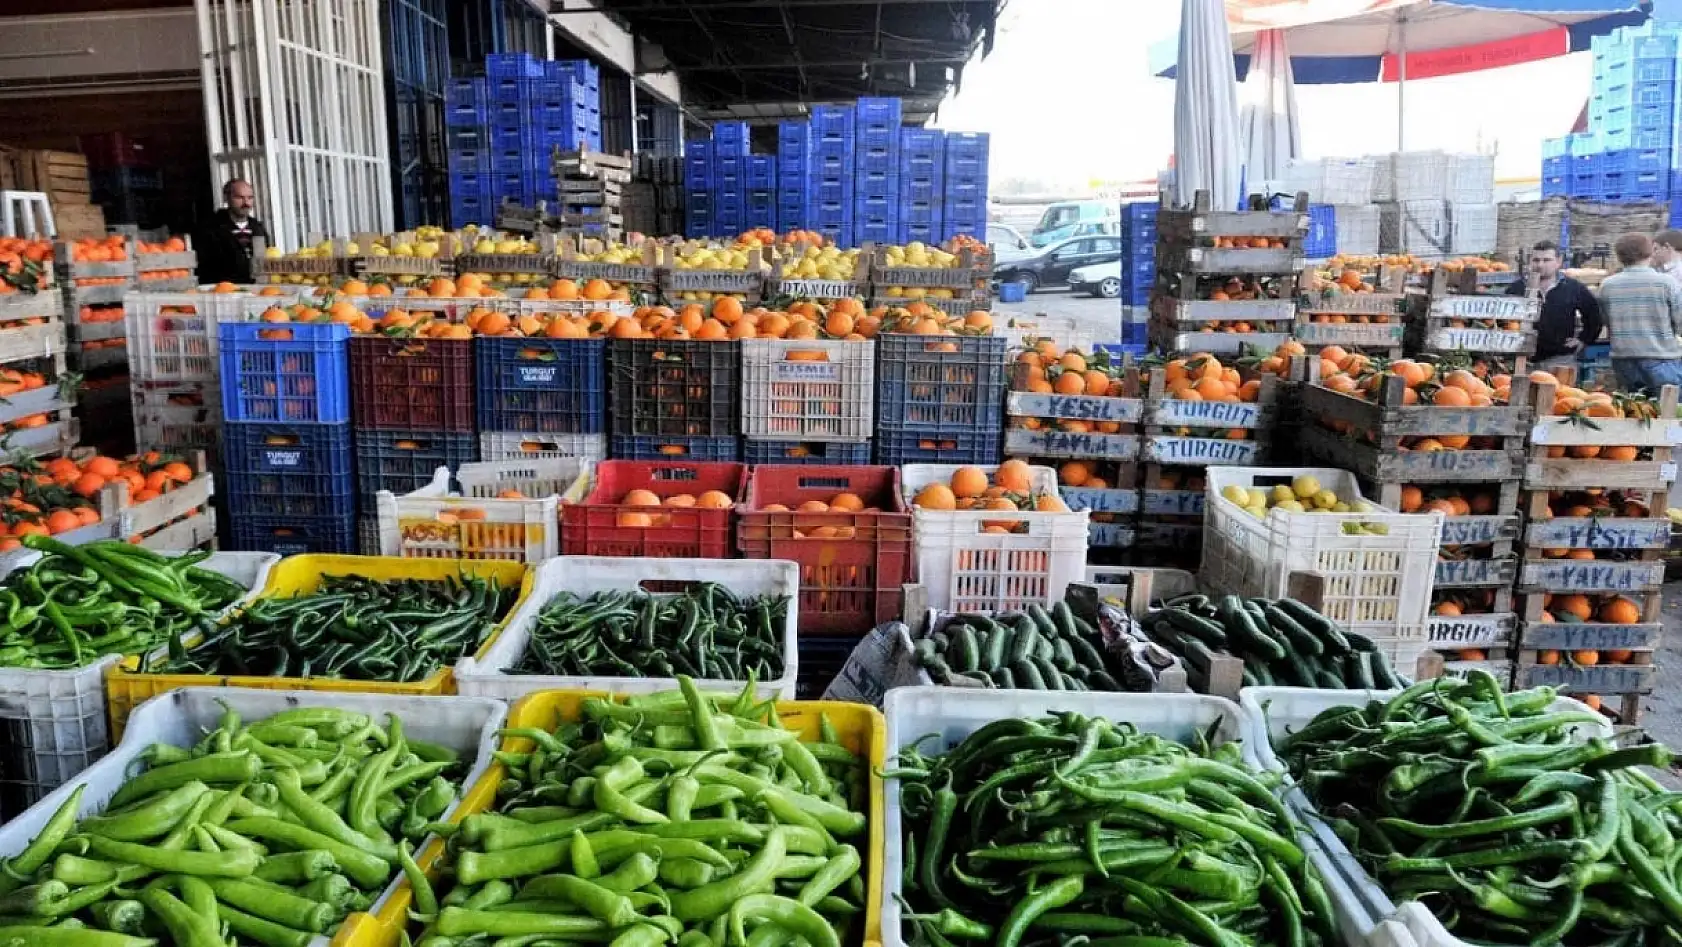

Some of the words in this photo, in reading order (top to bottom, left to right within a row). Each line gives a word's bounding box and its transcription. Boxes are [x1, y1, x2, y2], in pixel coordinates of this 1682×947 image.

[519, 366, 557, 375] TURGUT
[778, 364, 837, 374] KISMET
[1162, 400, 1254, 426] TURGUT
[1167, 440, 1251, 462] TURGUT
[1562, 565, 1632, 589] YAYLA
